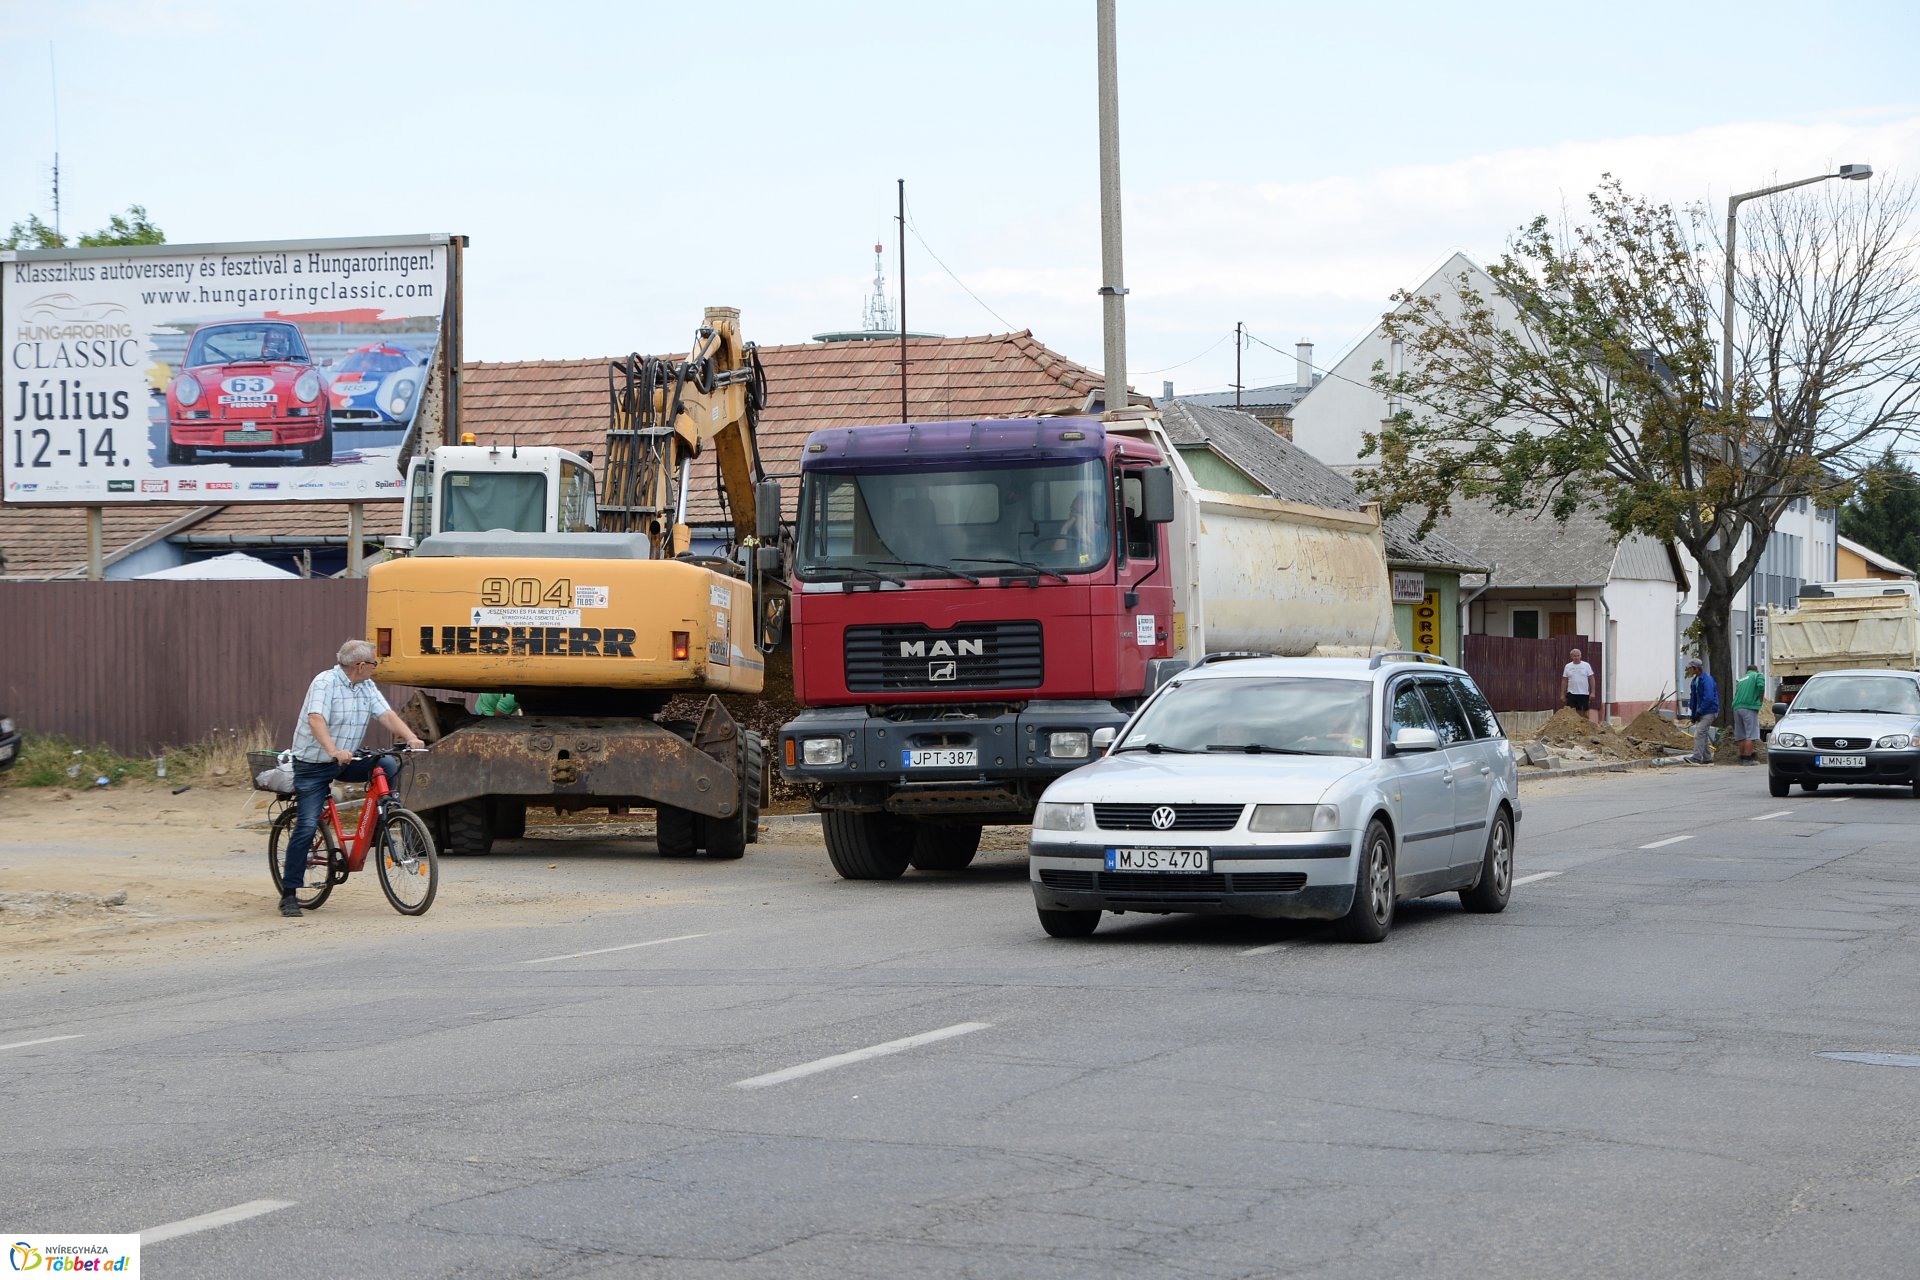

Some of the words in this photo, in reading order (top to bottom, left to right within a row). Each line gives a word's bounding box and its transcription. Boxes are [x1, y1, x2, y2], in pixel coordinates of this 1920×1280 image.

[15, 262, 95, 283] Klasszikus
[100, 258, 194, 283] autóverseny
[200, 257, 215, 277] és
[221, 253, 288, 277] fesztivál
[293, 258, 302, 273] a
[308, 249, 434, 279] Hungaroringen!
[141, 280, 433, 307] www.hungaroringclassic.com
[17, 324, 132, 341] HUNGARORING
[13, 339, 139, 370] CLASSIC
[231, 378, 264, 393] 63
[14, 379, 129, 421] Július
[221, 394, 274, 403] Shell
[14, 428, 130, 468] 12-14.
[482, 577, 572, 607] 904
[420, 626, 637, 658] LIEBHERR
[900, 639, 983, 657] MAN
[913, 751, 974, 765] JPT-387
[1821, 757, 1864, 766] LMN-514
[1119, 850, 1203, 869] MJS-470
